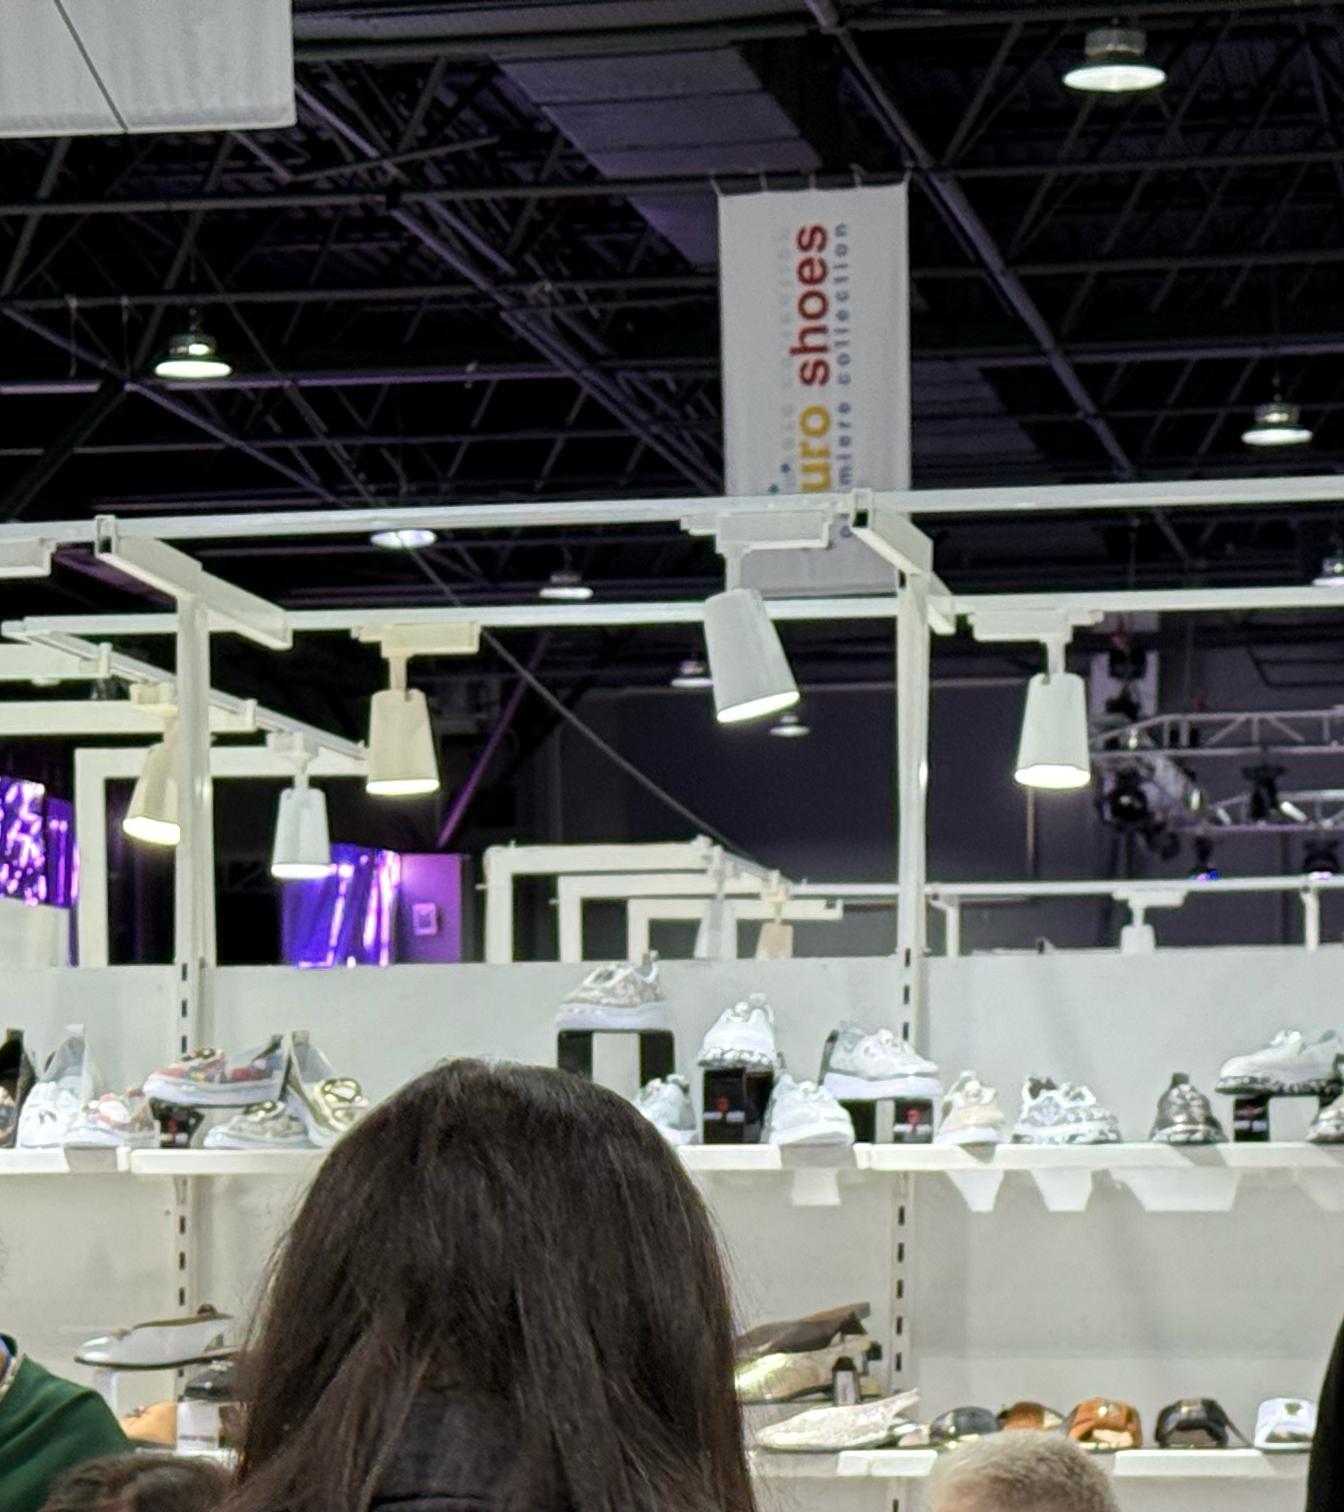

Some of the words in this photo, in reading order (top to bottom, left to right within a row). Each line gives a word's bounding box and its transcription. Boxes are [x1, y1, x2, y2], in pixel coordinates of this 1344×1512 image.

[790, 224, 830, 386] shoes
[833, 223, 851, 385] collection
[799, 404, 831, 493] uro
